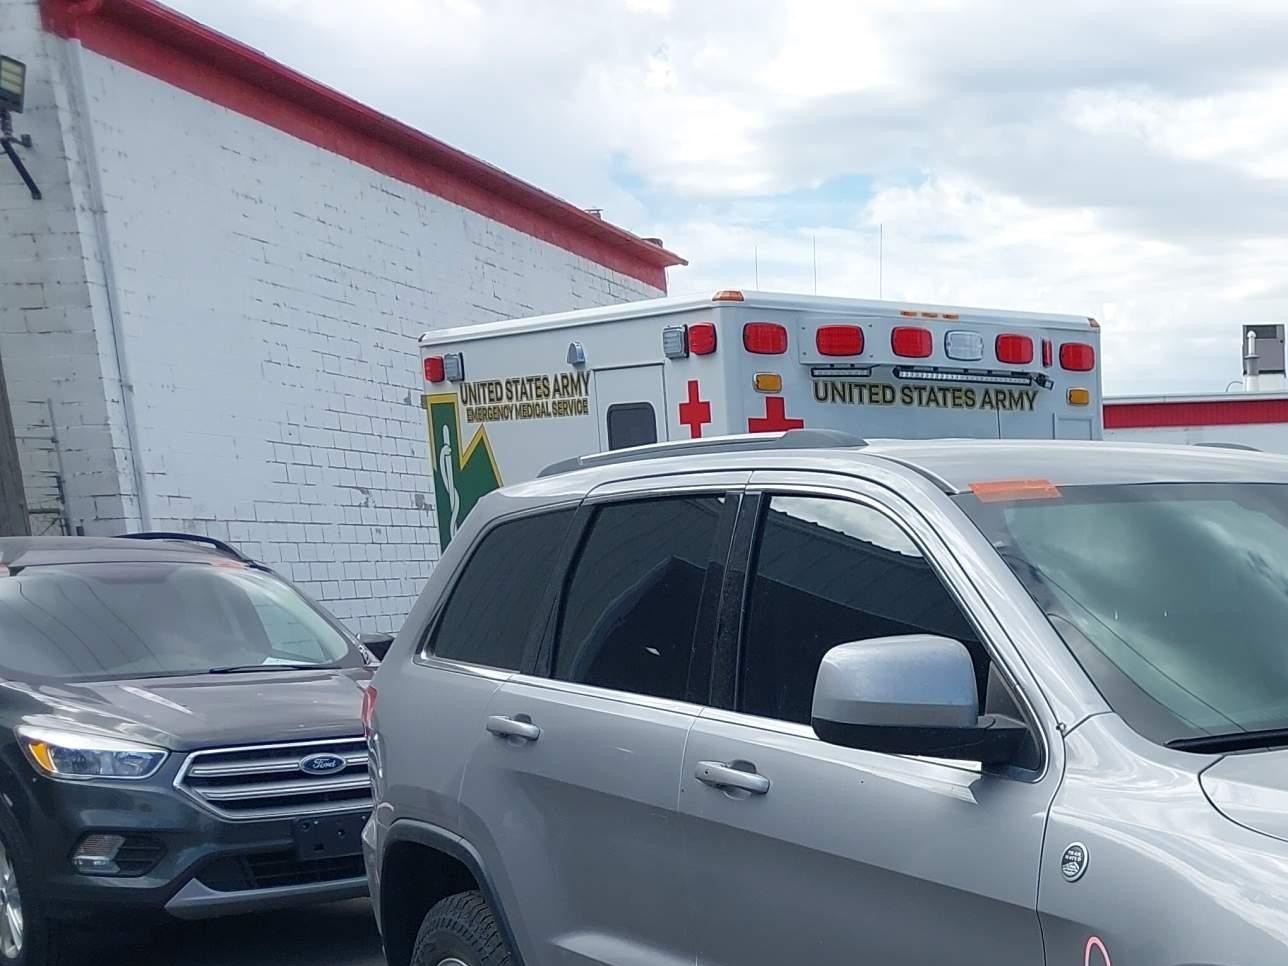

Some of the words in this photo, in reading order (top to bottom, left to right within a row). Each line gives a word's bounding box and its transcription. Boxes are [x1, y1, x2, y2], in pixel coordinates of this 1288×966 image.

[460, 380, 503, 405] UNITED
[505, 375, 550, 401] STATES
[553, 370, 590, 398] ARMY
[814, 381, 896, 405] UNITED
[900, 384, 976, 408] STATES
[979, 388, 1039, 411] ARMY
[466, 403, 515, 423] EMERGENCY
[515, 400, 551, 420] MEDICAL
[552, 397, 589, 417] SERVICE
